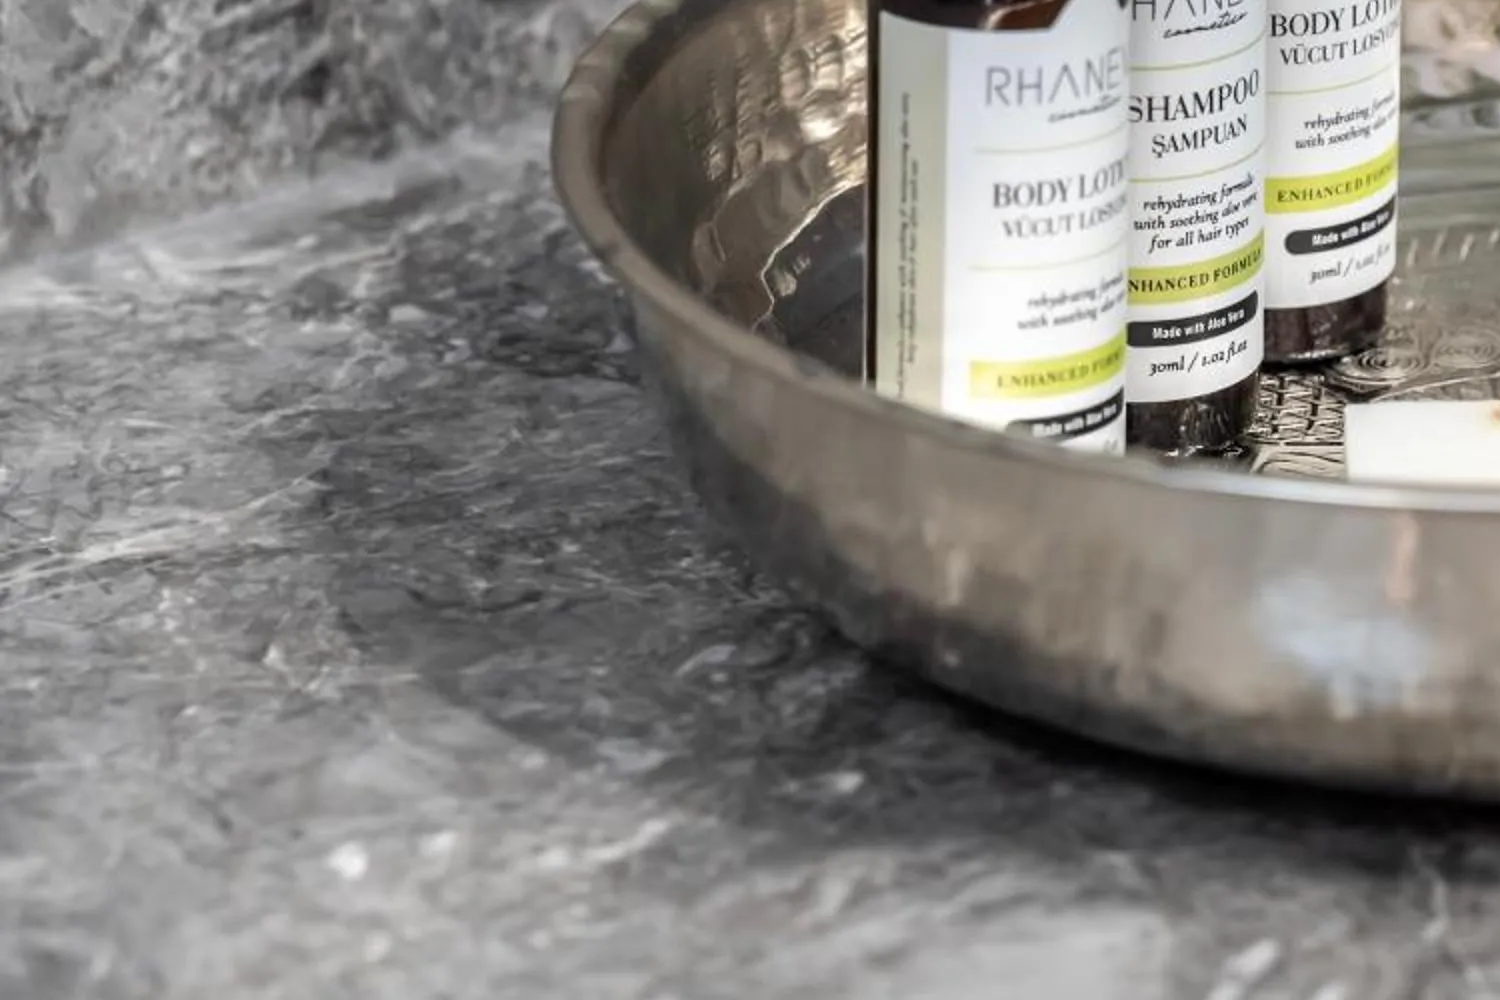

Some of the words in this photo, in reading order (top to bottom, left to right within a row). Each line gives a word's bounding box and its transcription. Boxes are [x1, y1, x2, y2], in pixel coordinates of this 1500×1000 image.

[1163, 11, 1248, 38] cosmetics
[1270, 7, 1344, 37] BODY
[1280, 41, 1348, 66] VÜCUT
[985, 46, 1123, 106] RHANE
[1128, 68, 1259, 122] SHAMPOO
[1304, 107, 1369, 132] rehydrating
[1152, 113, 1247, 158] ŞAMPUAN
[1295, 134, 1325, 150] with
[993, 176, 1072, 208] BODY
[1079, 158, 1125, 199] LOTI
[1277, 177, 1363, 202] ENHANCED
[1143, 190, 1217, 215] rehydrating
[1134, 216, 1165, 231] with
[1169, 208, 1219, 229] soothing
[1149, 235, 1171, 253] for
[1176, 230, 1193, 247] all
[1197, 226, 1222, 243] hair
[1226, 216, 1250, 239] types
[1312, 232, 1338, 246] Made
[1128, 270, 1208, 292] NHANCED
[1152, 326, 1182, 340] Made
[1185, 320, 1206, 335] with
[1208, 316, 1227, 331] Aloe
[1228, 308, 1245, 325] Vera
[998, 364, 1089, 388] ENHANCED
[1149, 356, 1184, 376] 30ml
